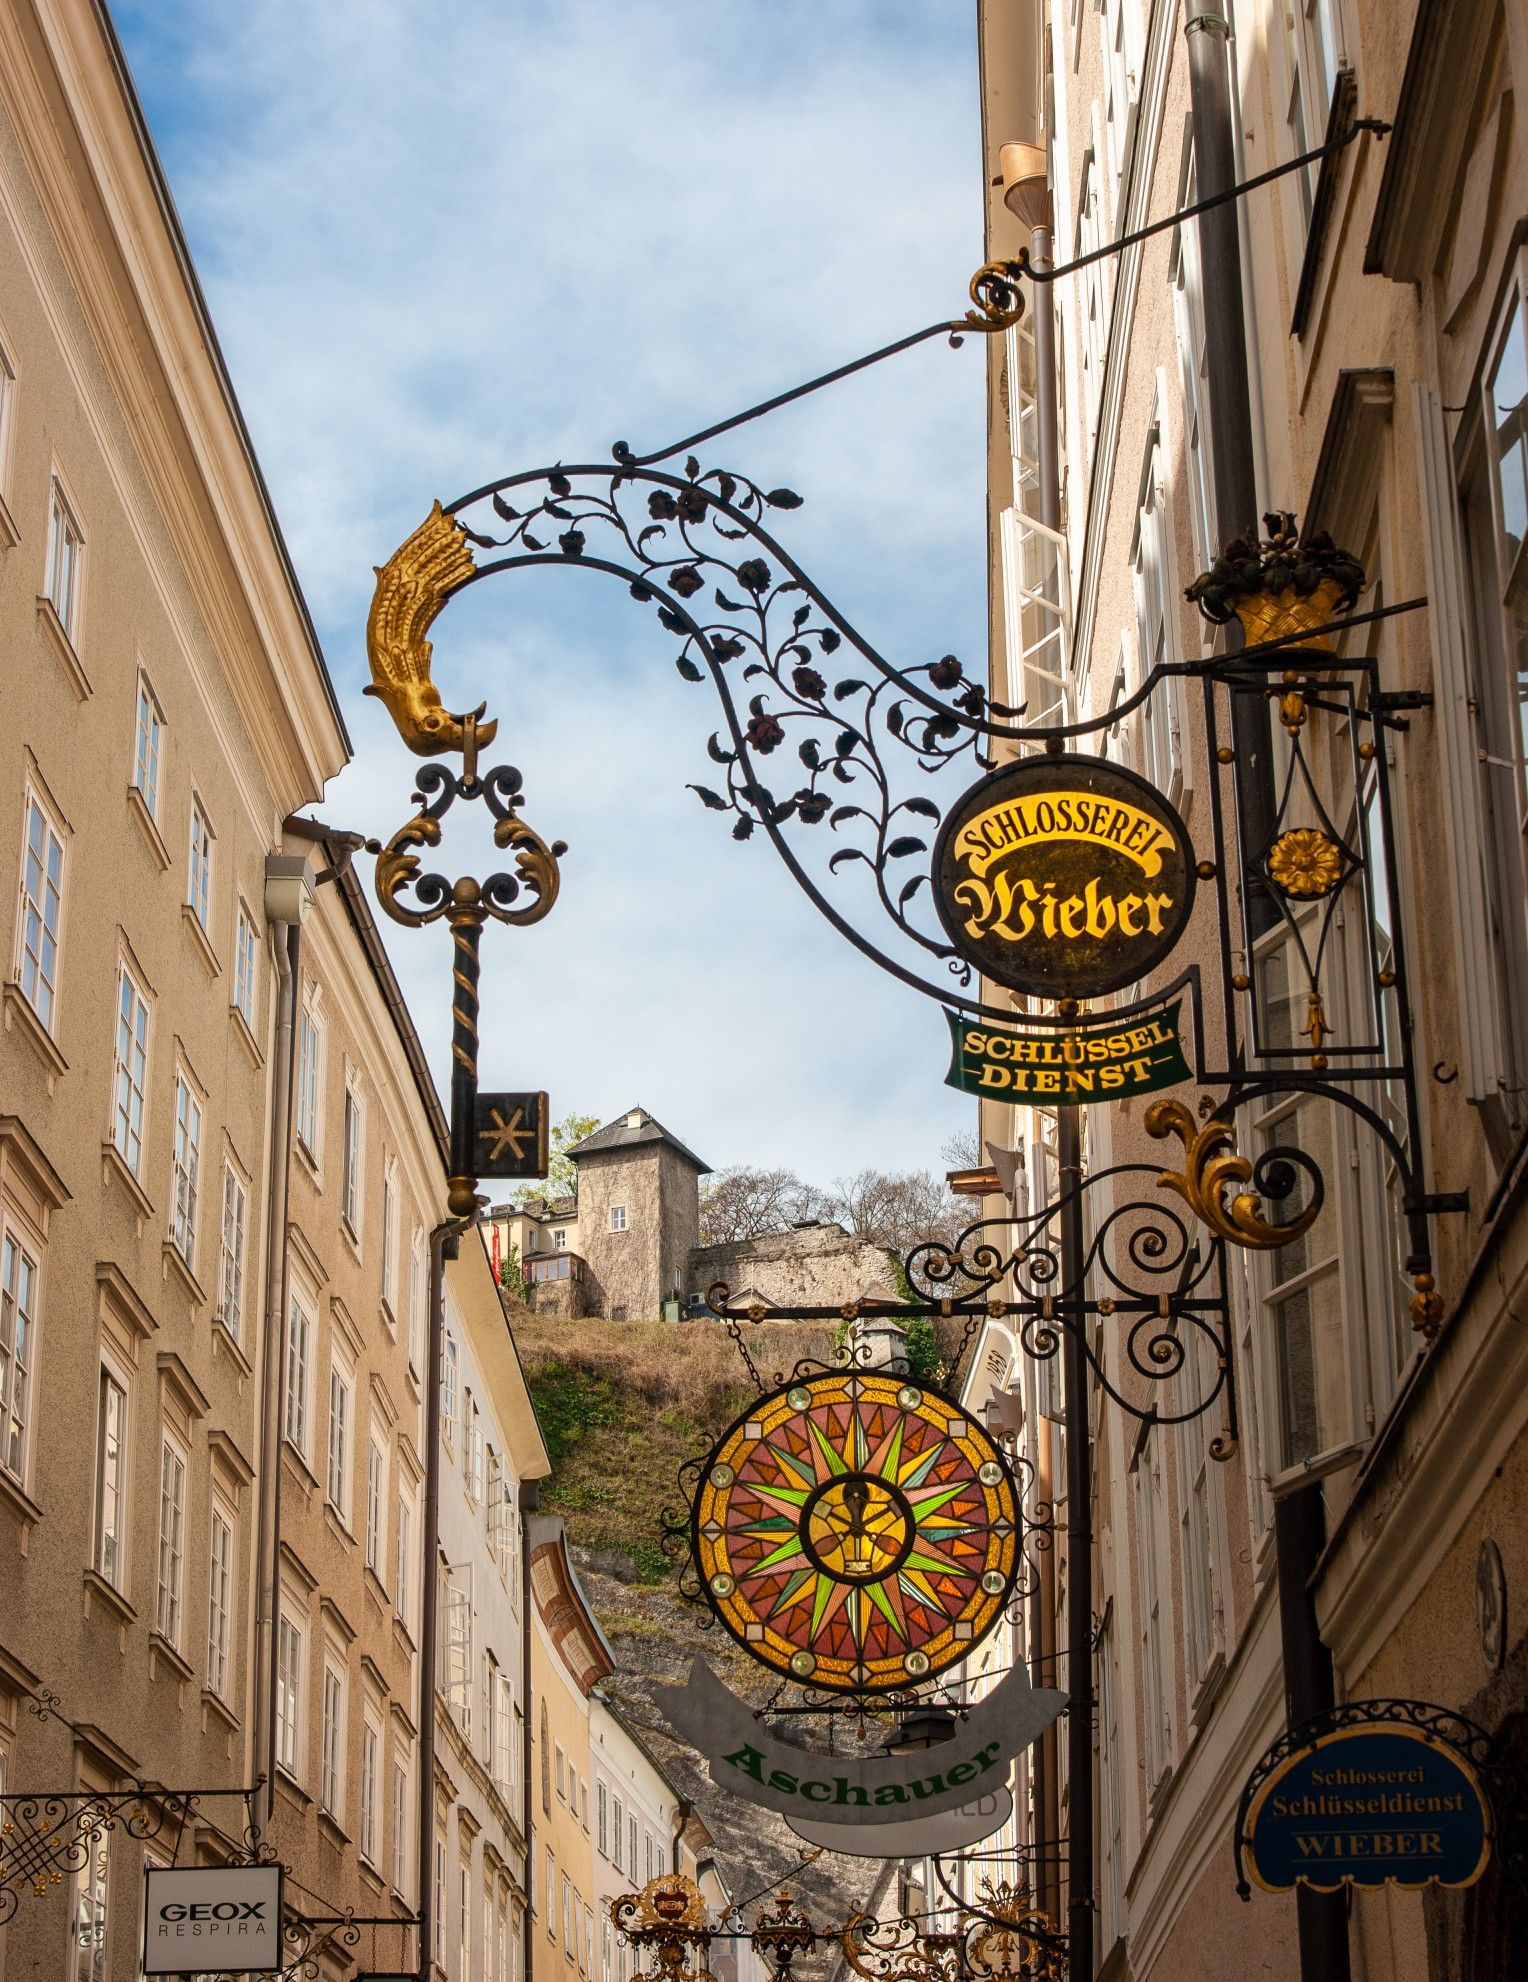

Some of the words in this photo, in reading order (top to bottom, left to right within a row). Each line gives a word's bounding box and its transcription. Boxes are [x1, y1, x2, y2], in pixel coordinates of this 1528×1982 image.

[963, 799, 1163, 861] SCHLOSSEREI
[954, 869, 1174, 941] Wieber
[963, 1021, 1175, 1064] SCHLÜSSEL
[979, 1056, 1152, 1093] DIENST
[721, 1740, 1002, 1806] Aschauer
[1311, 1766, 1426, 1787] Schlosserei
[1272, 1791, 1465, 1818] Schlüsseldienst
[1295, 1832, 1444, 1857] WIEBER
[159, 1901, 266, 1922] GEOX
[158, 1922, 266, 1937] RESPIRA
